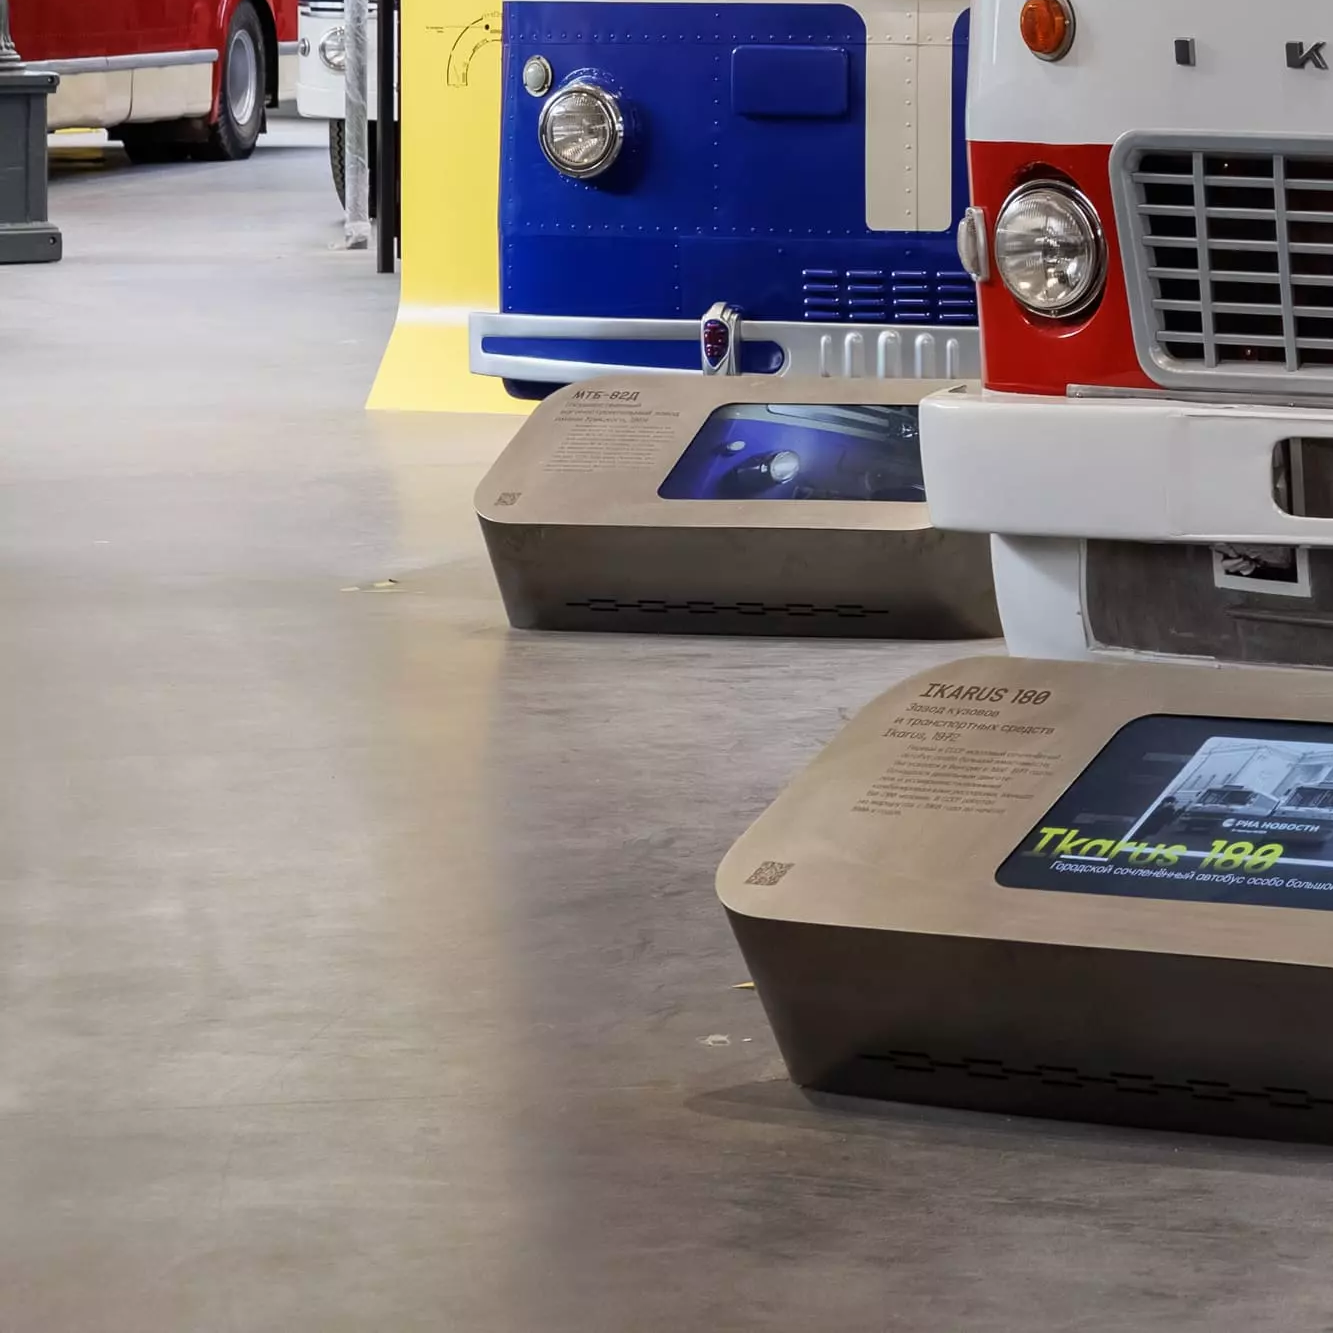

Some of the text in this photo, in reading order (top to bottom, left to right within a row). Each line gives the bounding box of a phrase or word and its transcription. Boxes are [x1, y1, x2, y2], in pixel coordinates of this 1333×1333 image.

[919, 683, 1052, 705] IKARUS 180
[906, 702, 946, 715] Завод
[881, 728, 928, 741] Ikarus,
[905, 717, 999, 732] транспортных
[1001, 724, 1056, 736] средств
[1235, 819, 1260, 829] РИА
[1261, 821, 1320, 832] НОВОСТИ
[1026, 827, 1284, 873] Ikarus 180
[1050, 860, 1113, 874] Городской
[1113, 867, 1196, 880] сочленённый
[1196, 873, 1246, 885] автобус
[1246, 877, 1284, 887] особо
